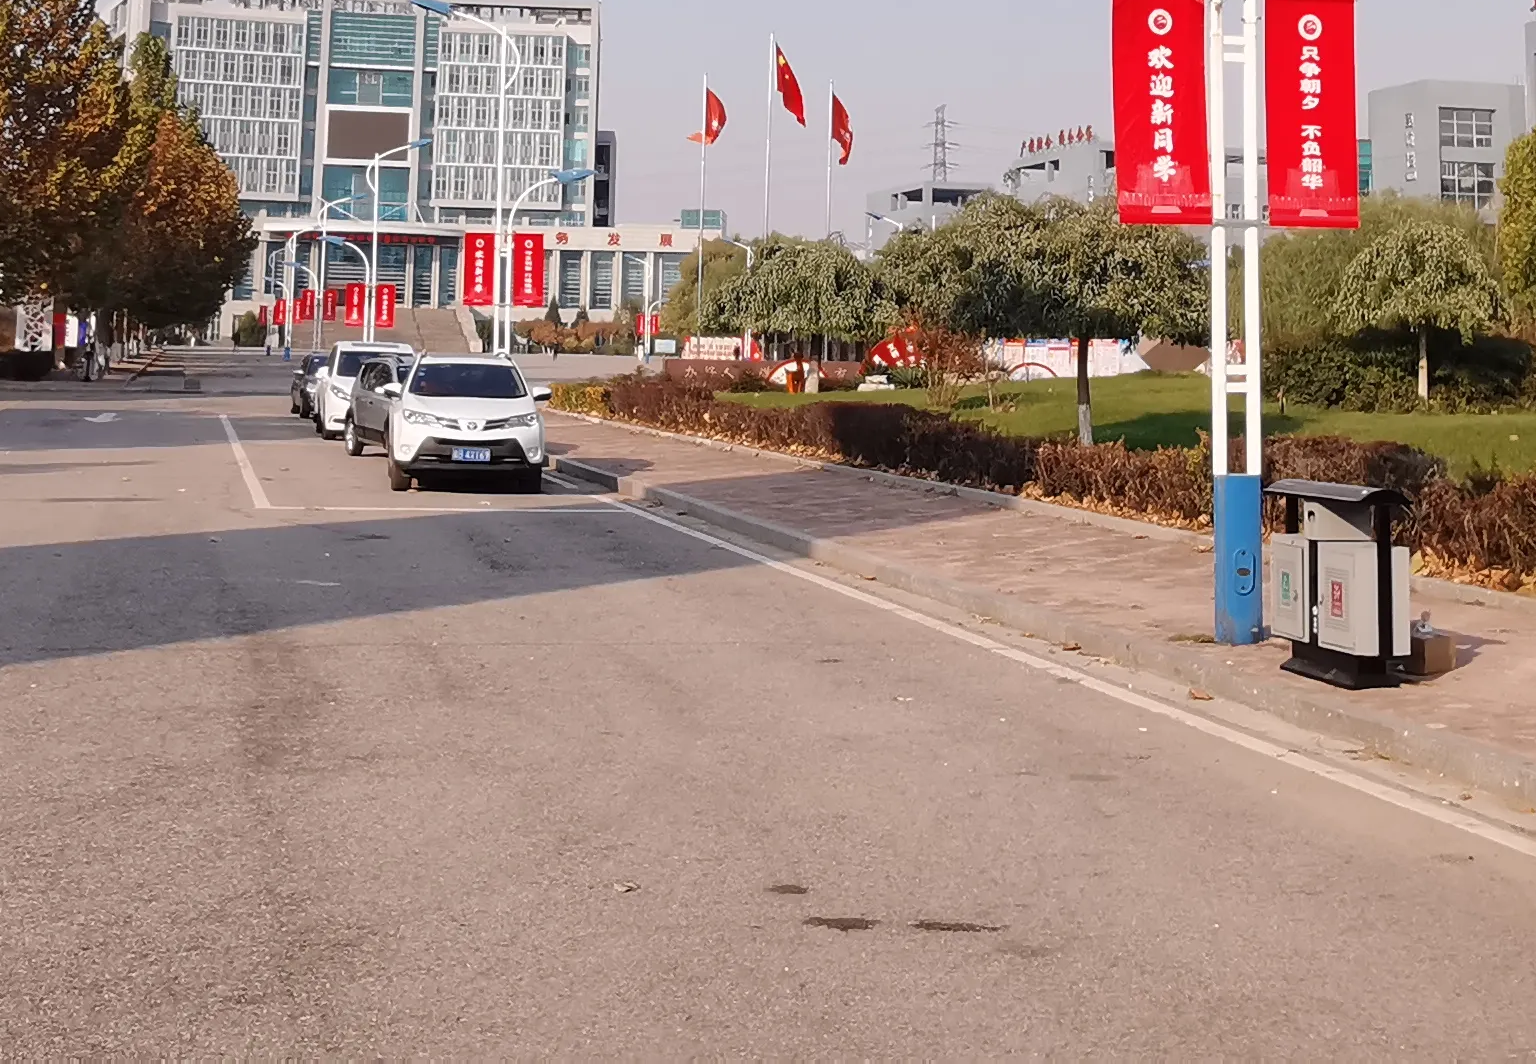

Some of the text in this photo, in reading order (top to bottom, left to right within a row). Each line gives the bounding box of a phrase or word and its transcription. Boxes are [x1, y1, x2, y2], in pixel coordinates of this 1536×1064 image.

[1147, 45, 1177, 182] 欢迎新同学
[1299, 45, 1324, 190] 只争朝夕 不负韶华
